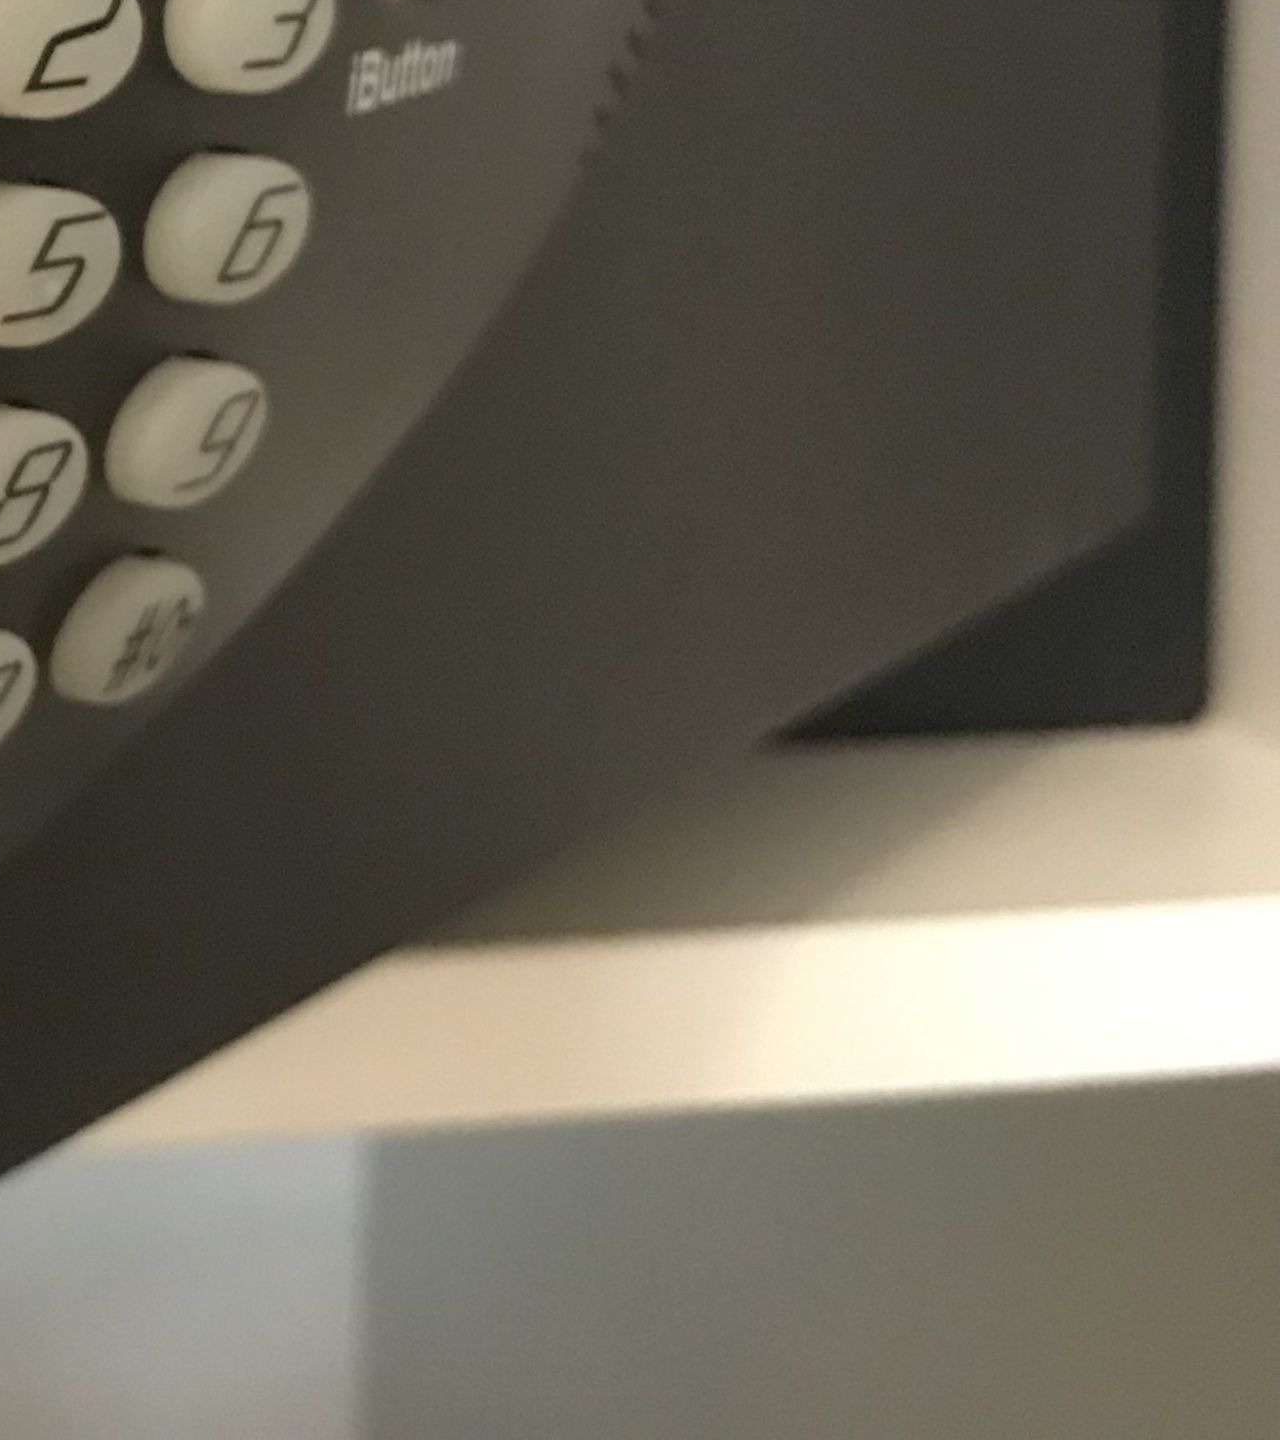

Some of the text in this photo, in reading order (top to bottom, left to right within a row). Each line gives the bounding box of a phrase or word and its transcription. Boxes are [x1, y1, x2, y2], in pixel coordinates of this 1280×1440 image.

[346, 38, 460, 117] iButton
[0, 210, 109, 325] 5
[217, 183, 302, 285] 6
[174, 390, 260, 493] 9
